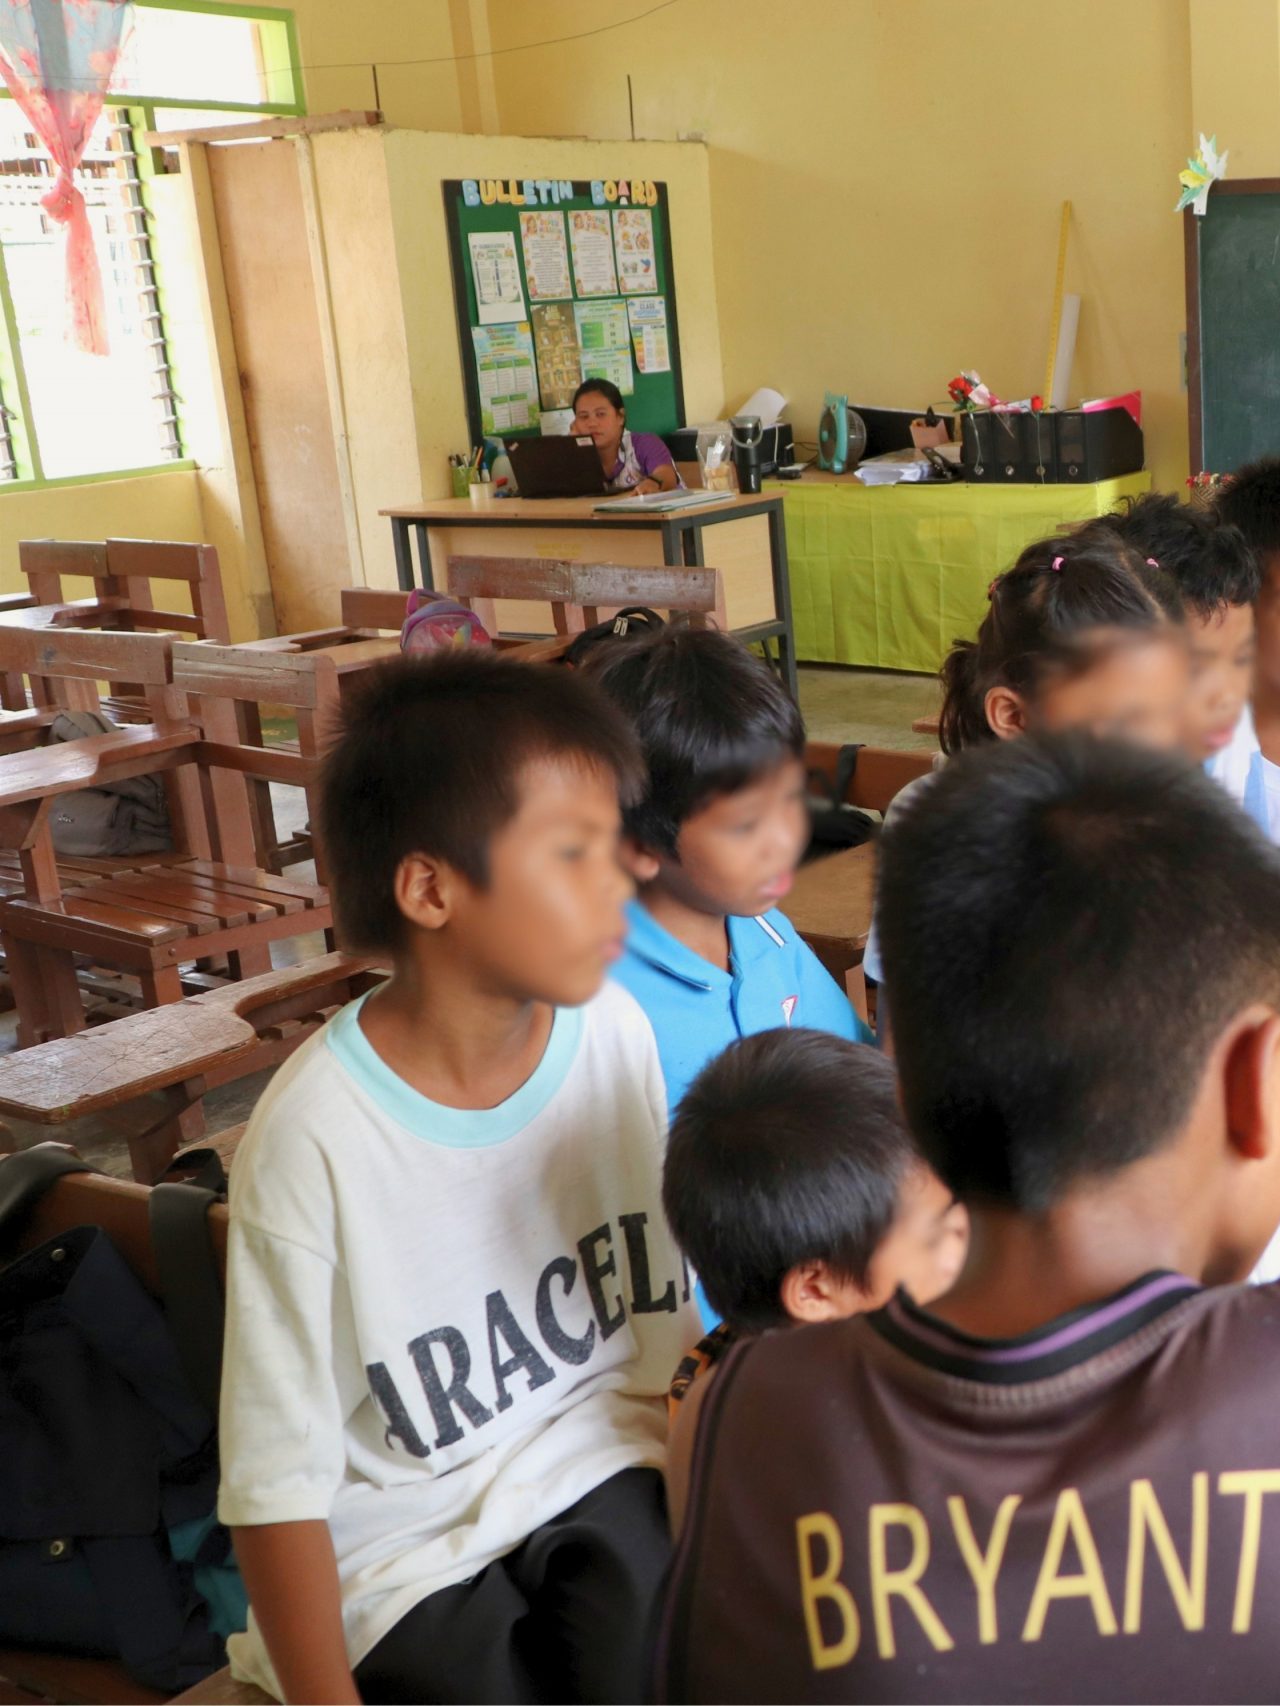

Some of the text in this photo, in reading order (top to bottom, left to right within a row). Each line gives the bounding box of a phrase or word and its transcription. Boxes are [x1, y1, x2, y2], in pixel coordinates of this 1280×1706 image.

[462, 179, 658, 206] BULLETIN BOARD
[366, 1211, 692, 1459] ARACEL
